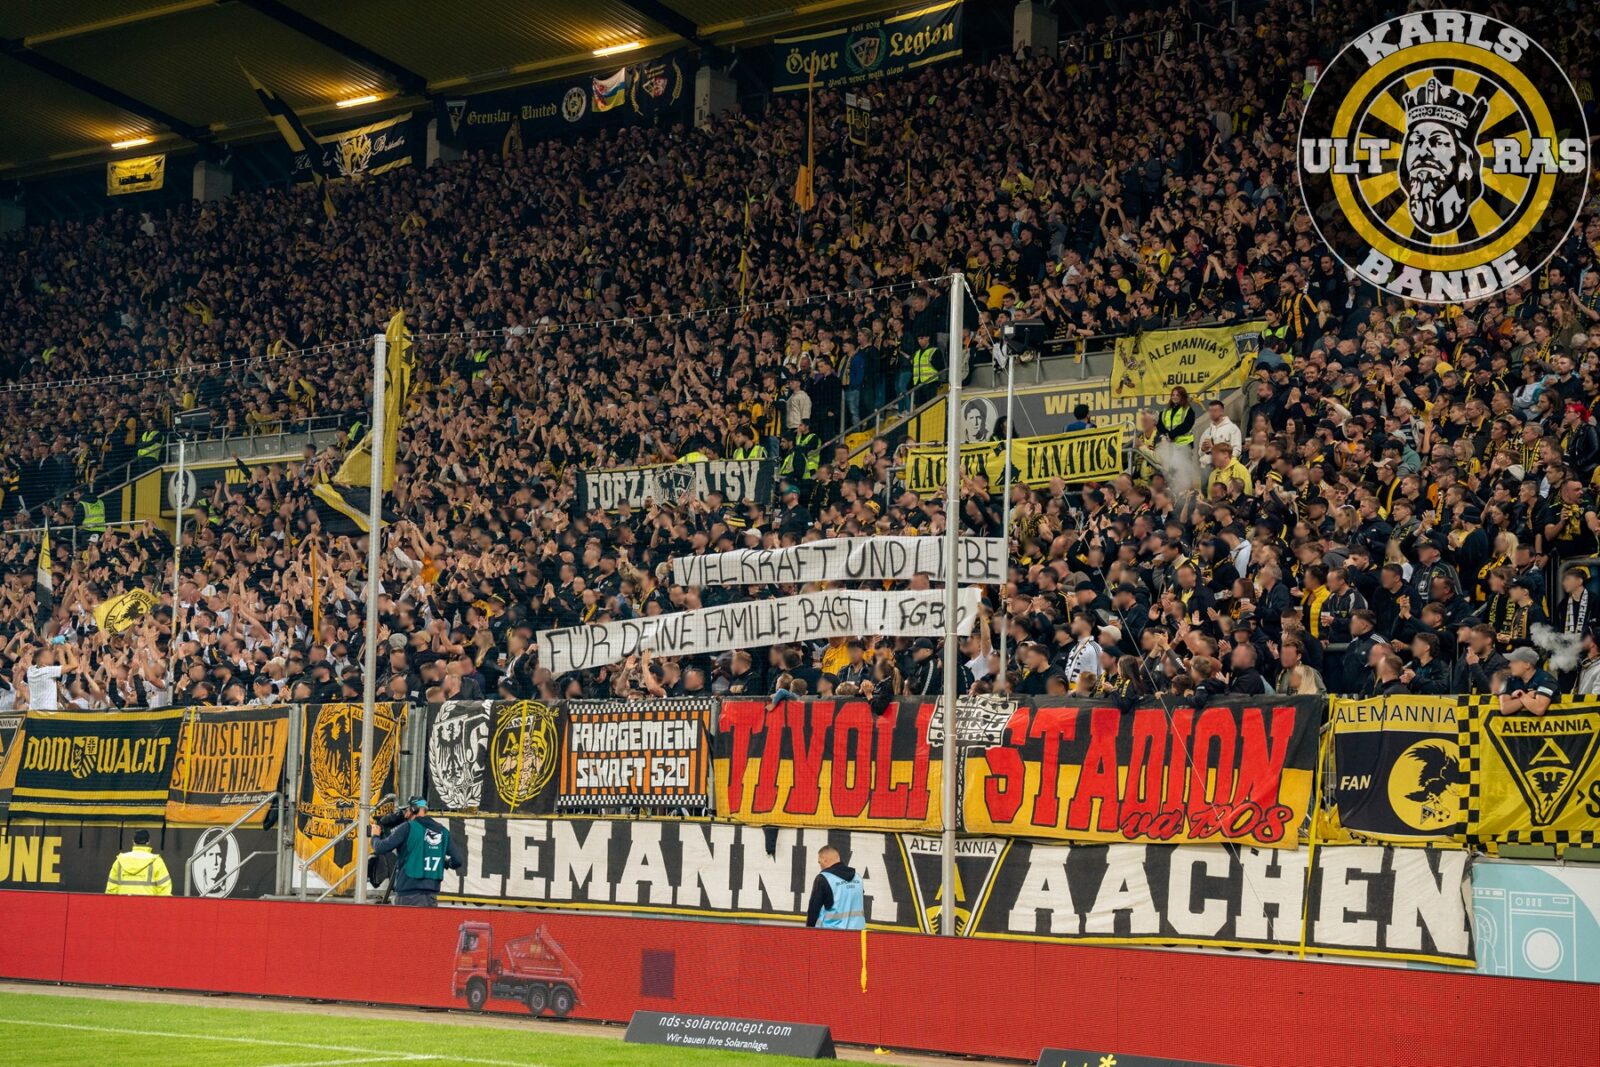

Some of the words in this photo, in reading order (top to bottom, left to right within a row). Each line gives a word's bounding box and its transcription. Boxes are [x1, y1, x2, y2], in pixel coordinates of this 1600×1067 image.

[785, 47, 838, 76] Öcher
[889, 23, 954, 57] Legion
[521, 102, 557, 120] United
[1148, 337, 1229, 364] ALEMANNIA'S
[1179, 354, 1197, 366] AU
[1026, 435, 1119, 480] FANATICS
[586, 468, 655, 511] FORZA
[694, 460, 760, 503] ATSV
[681, 549, 738, 587] VIEL
[740, 545, 837, 584] KRAFT
[845, 539, 907, 578] UND
[914, 537, 1000, 580] LIBE
[545, 622, 610, 673] FÜR
[621, 611, 695, 658] DEINE
[1335, 705, 1457, 725] ALEMANNIA
[1501, 718, 1593, 734] ALEMANNIA
[23, 735, 71, 773] DOM
[98, 736, 172, 774] WACHT
[177, 720, 278, 757] EUNDSCHAFT
[576, 757, 647, 789] SCHAFT
[650, 756, 690, 788] 520
[719, 700, 934, 821] TIVOLI
[984, 704, 1297, 832] STADION
[1340, 774, 1371, 791] FAN
[1187, 801, 1293, 843] 1908
[910, 837, 997, 854] ALEANNIA
[424, 856, 441, 871] 17
[1008, 842, 1470, 956] AACHEN
[658, 1015, 793, 1037] nds-solarconcept.com
[666, 1032, 682, 1043] Wir
[682, 1034, 706, 1045] bauen
[707, 1036, 724, 1046] Ihre
[725, 1037, 769, 1052] Solaranlage.
